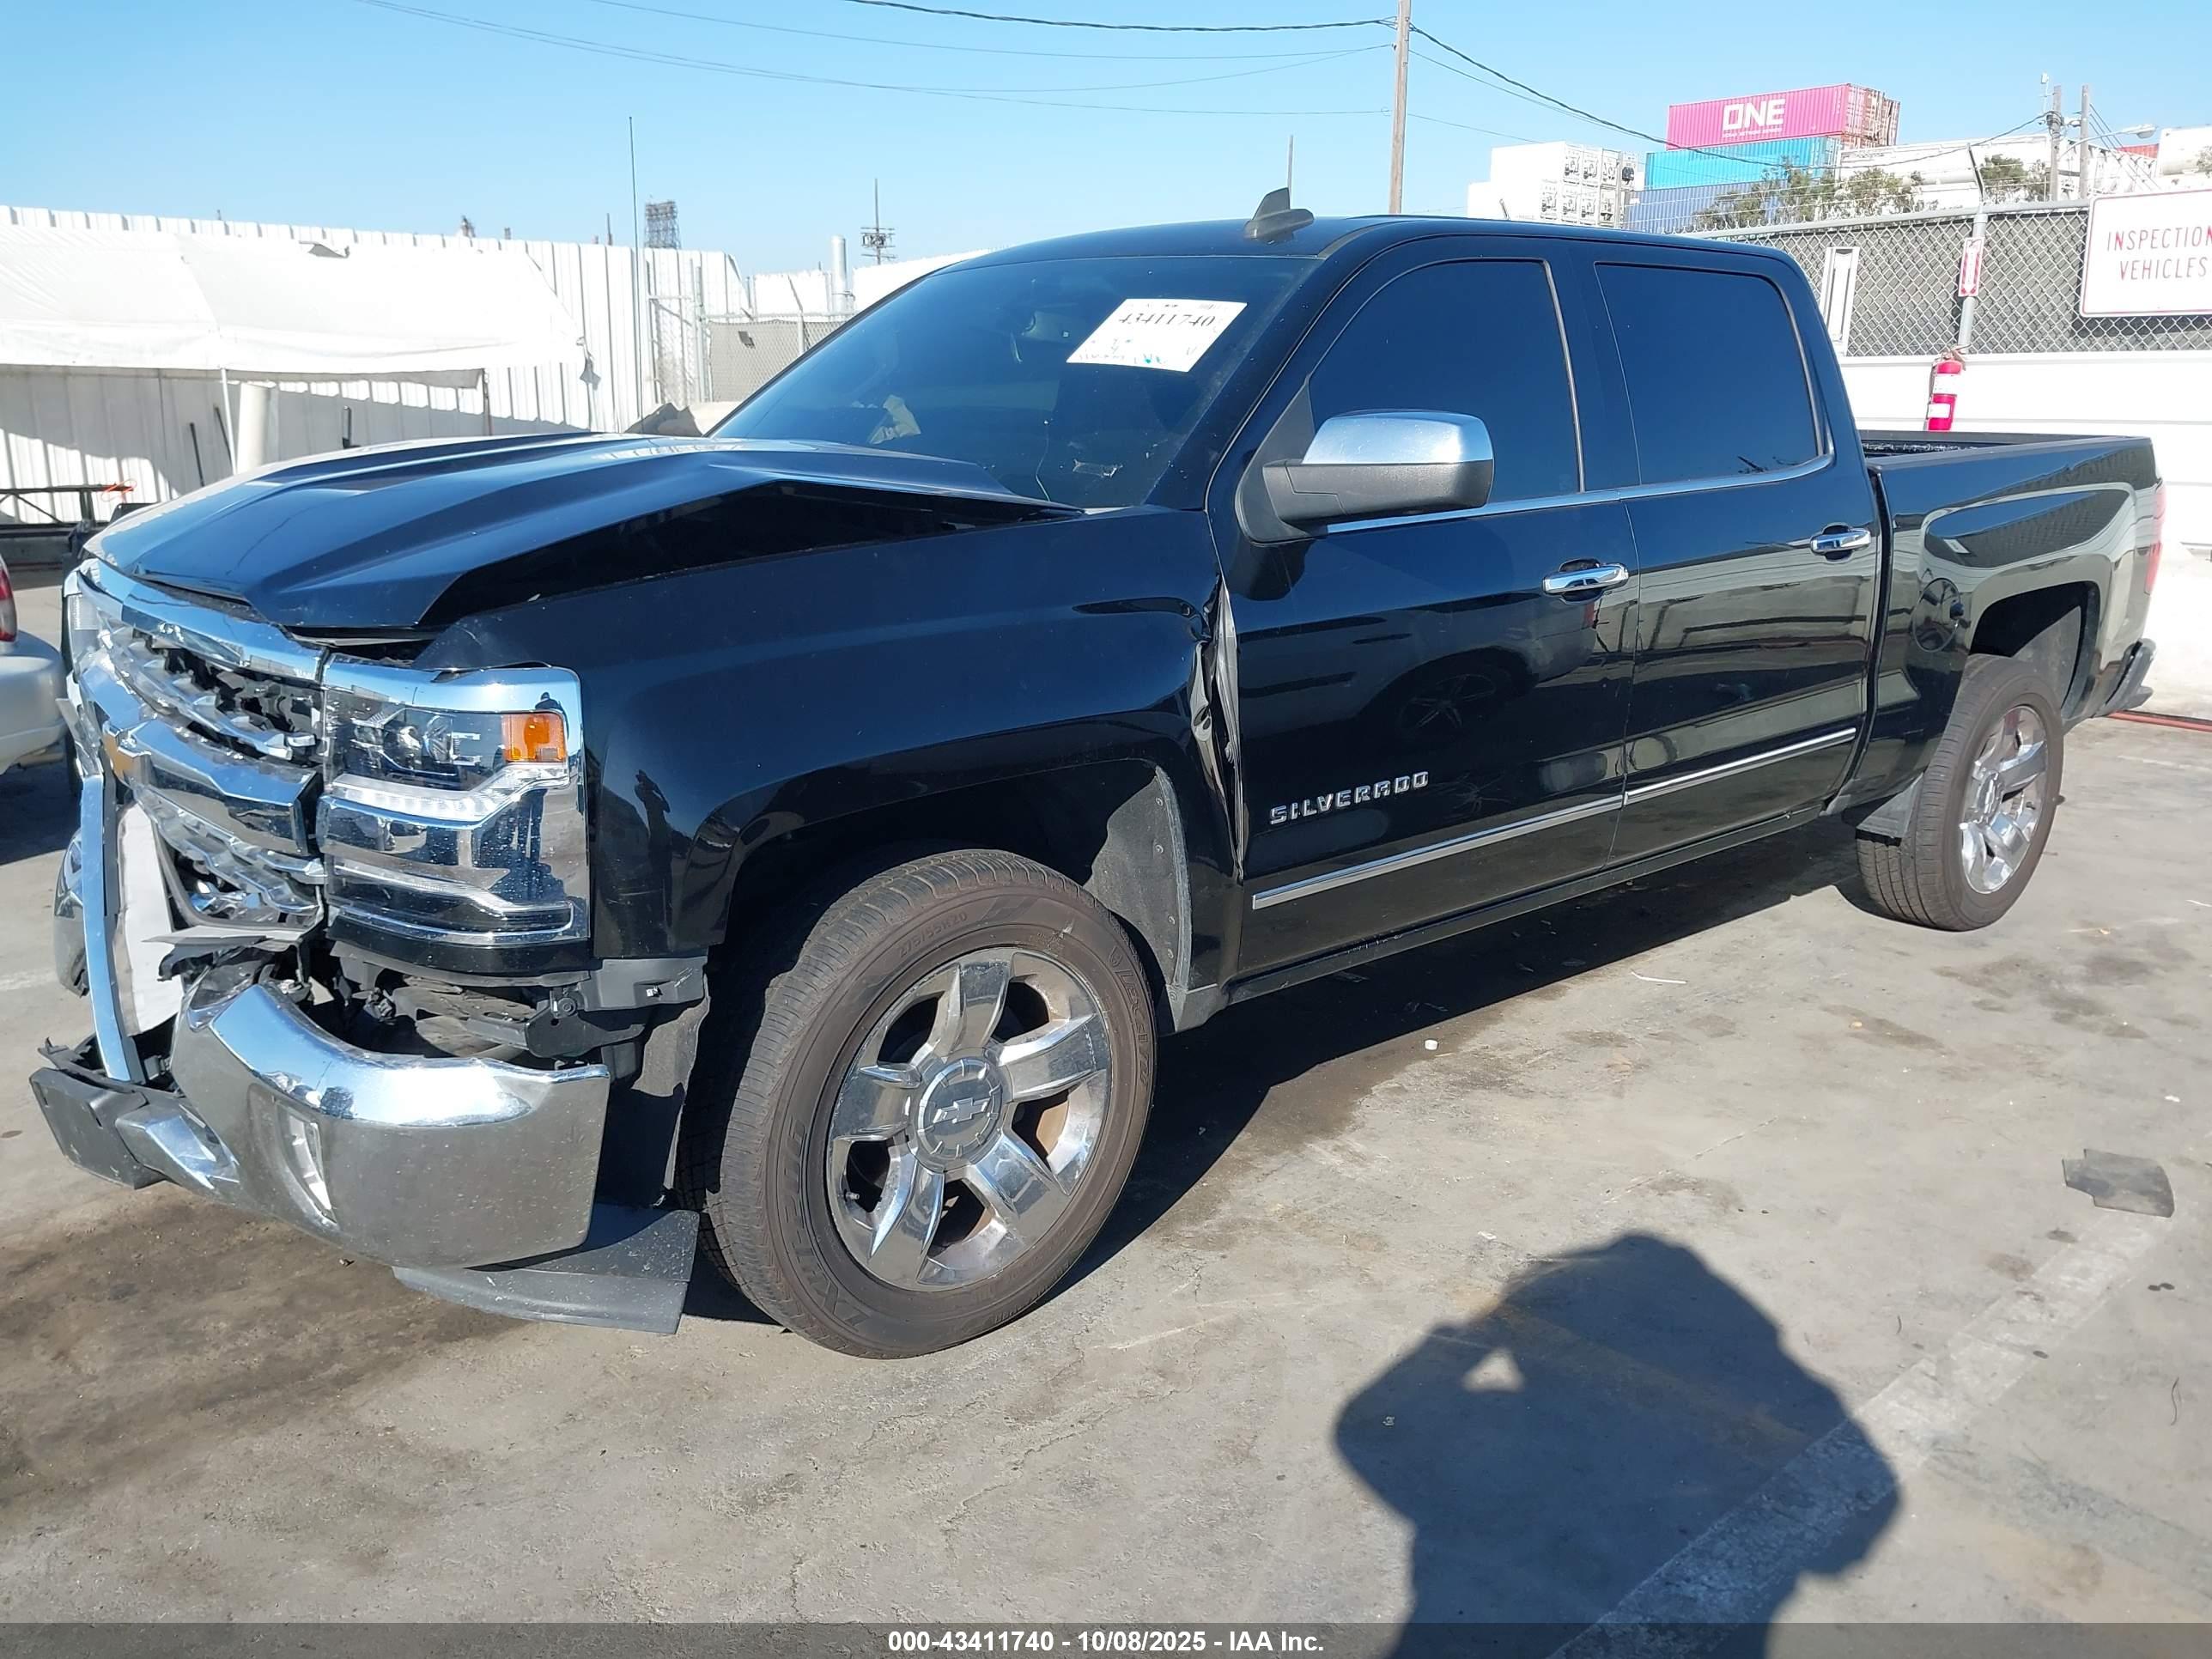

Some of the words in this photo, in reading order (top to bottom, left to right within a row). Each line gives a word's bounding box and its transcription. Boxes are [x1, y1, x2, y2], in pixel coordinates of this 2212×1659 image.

[1722, 98, 1786, 131] ONE
[2120, 257, 2208, 281] VEHICLES
[1119, 313, 1216, 326] 43411740
[1269, 771, 1429, 825] SILVERADO
